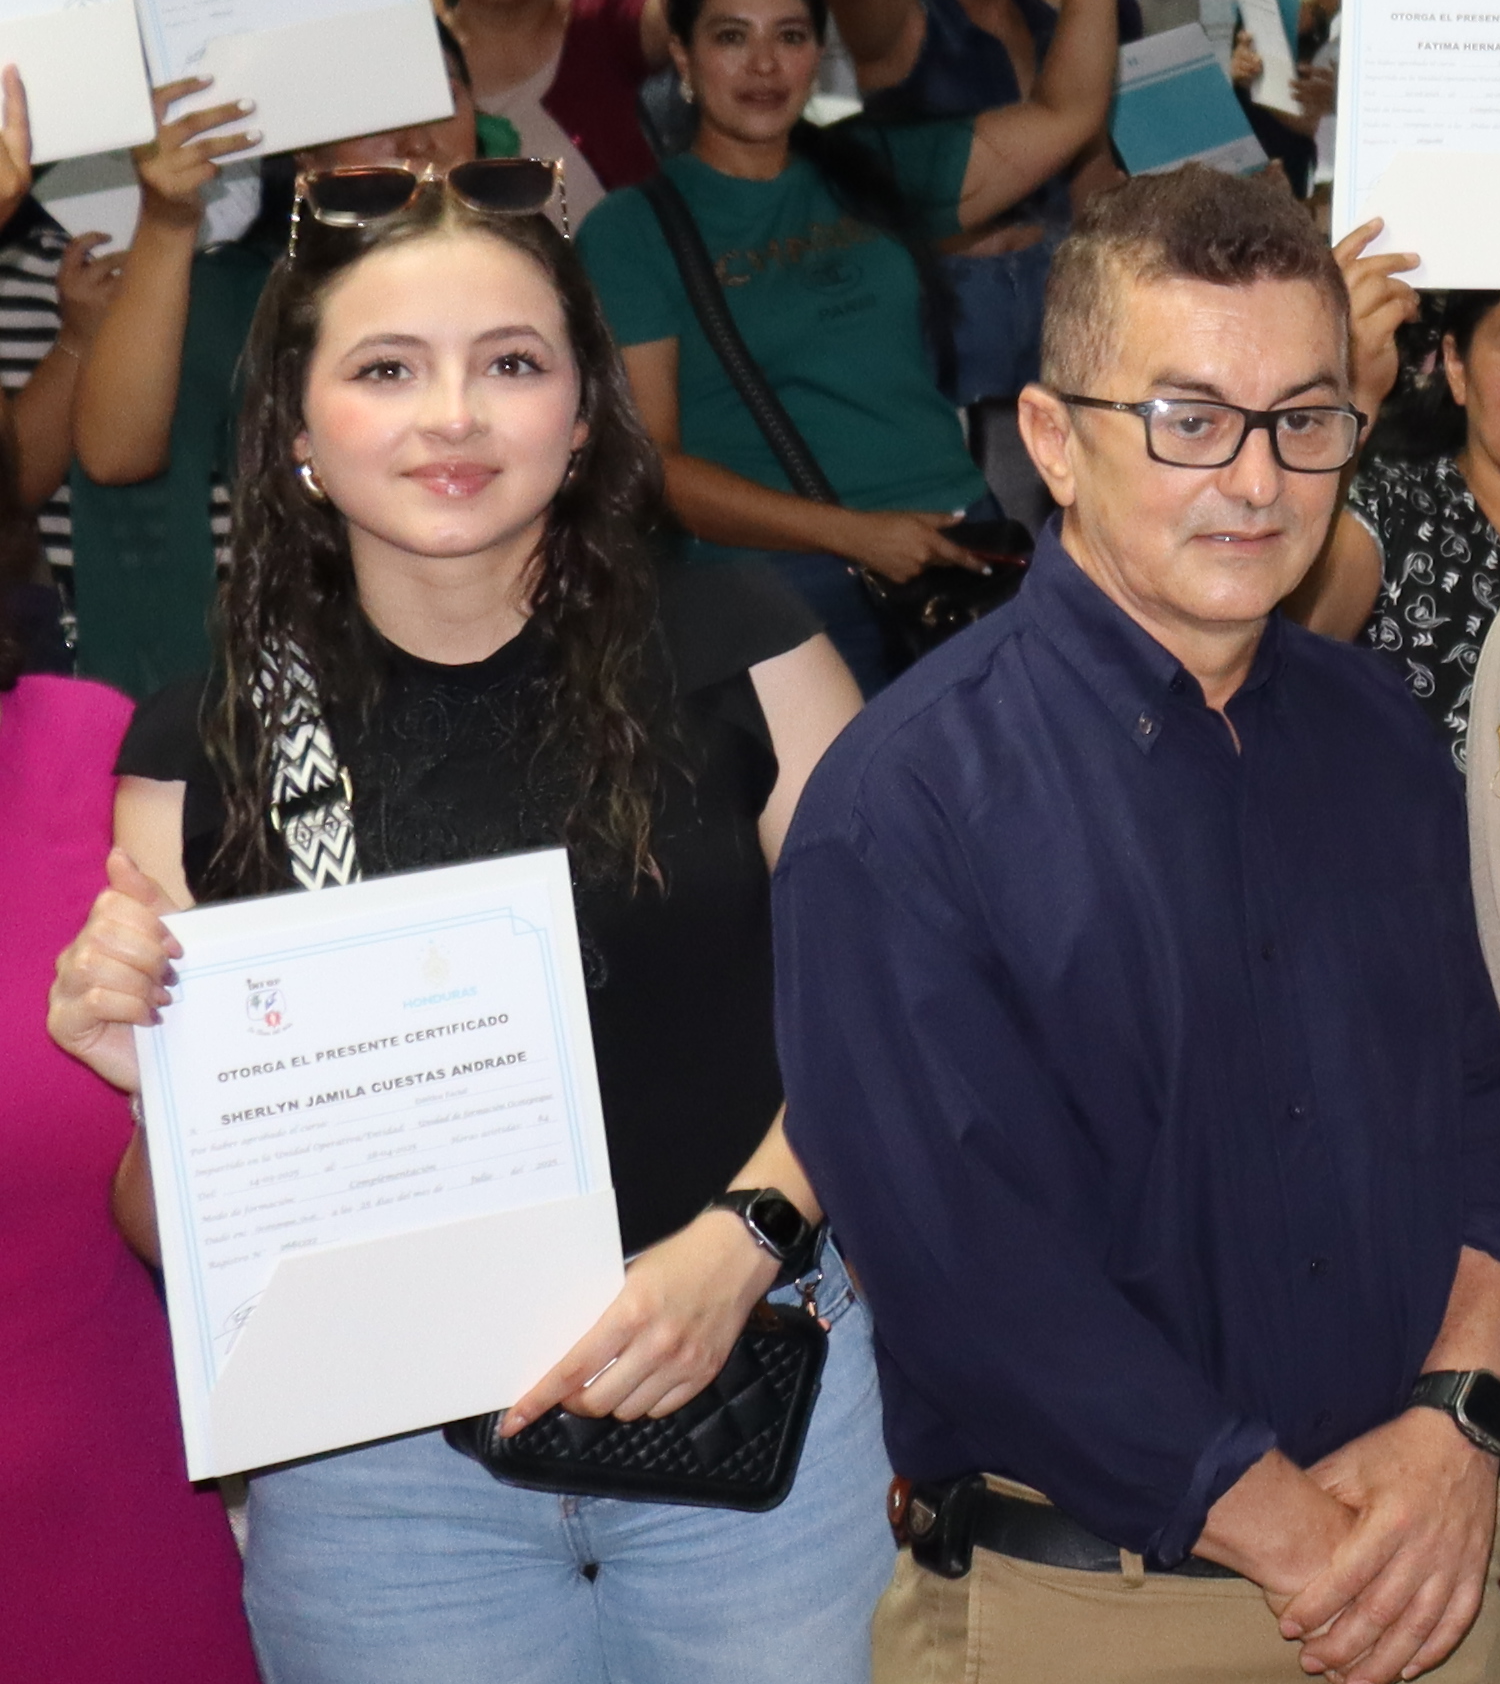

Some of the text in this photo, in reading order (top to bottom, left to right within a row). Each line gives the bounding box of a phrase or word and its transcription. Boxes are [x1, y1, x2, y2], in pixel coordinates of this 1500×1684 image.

[1390, 12, 1437, 23] OTORGA
[1439, 13, 1454, 22] EL
[402, 985, 478, 1011] HONDURAS
[217, 1013, 510, 1084] OTORGA EL PRESENTE CERTIFICADO
[220, 1050, 528, 1126] SHERLYN JAMILA CUESTAS ANDRADE
